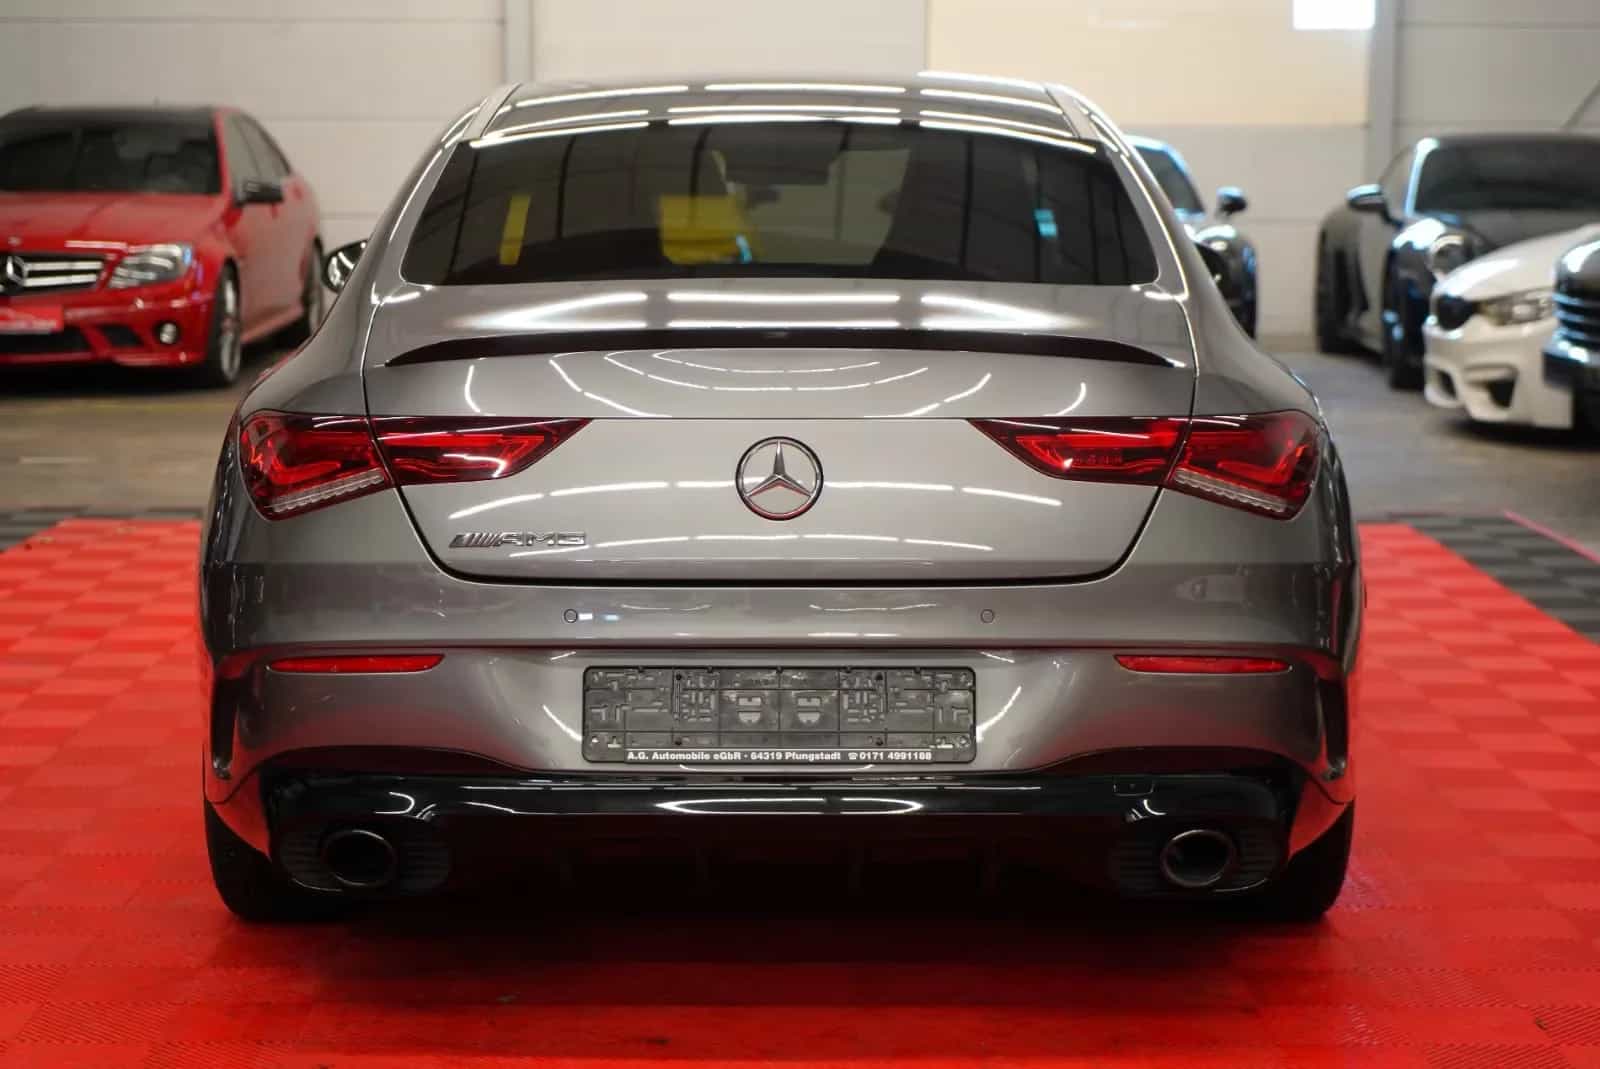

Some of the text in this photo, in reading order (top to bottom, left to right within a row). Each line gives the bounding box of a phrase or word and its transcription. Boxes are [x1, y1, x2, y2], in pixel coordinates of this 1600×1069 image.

[493, 531, 586, 547] AMG
[627, 751, 649, 760] A.G.
[652, 751, 711, 760] Automobile
[713, 751, 741, 760] eGbR
[750, 751, 782, 760] 64319
[785, 751, 841, 762] Pfungstadt
[859, 751, 884, 760] 0171
